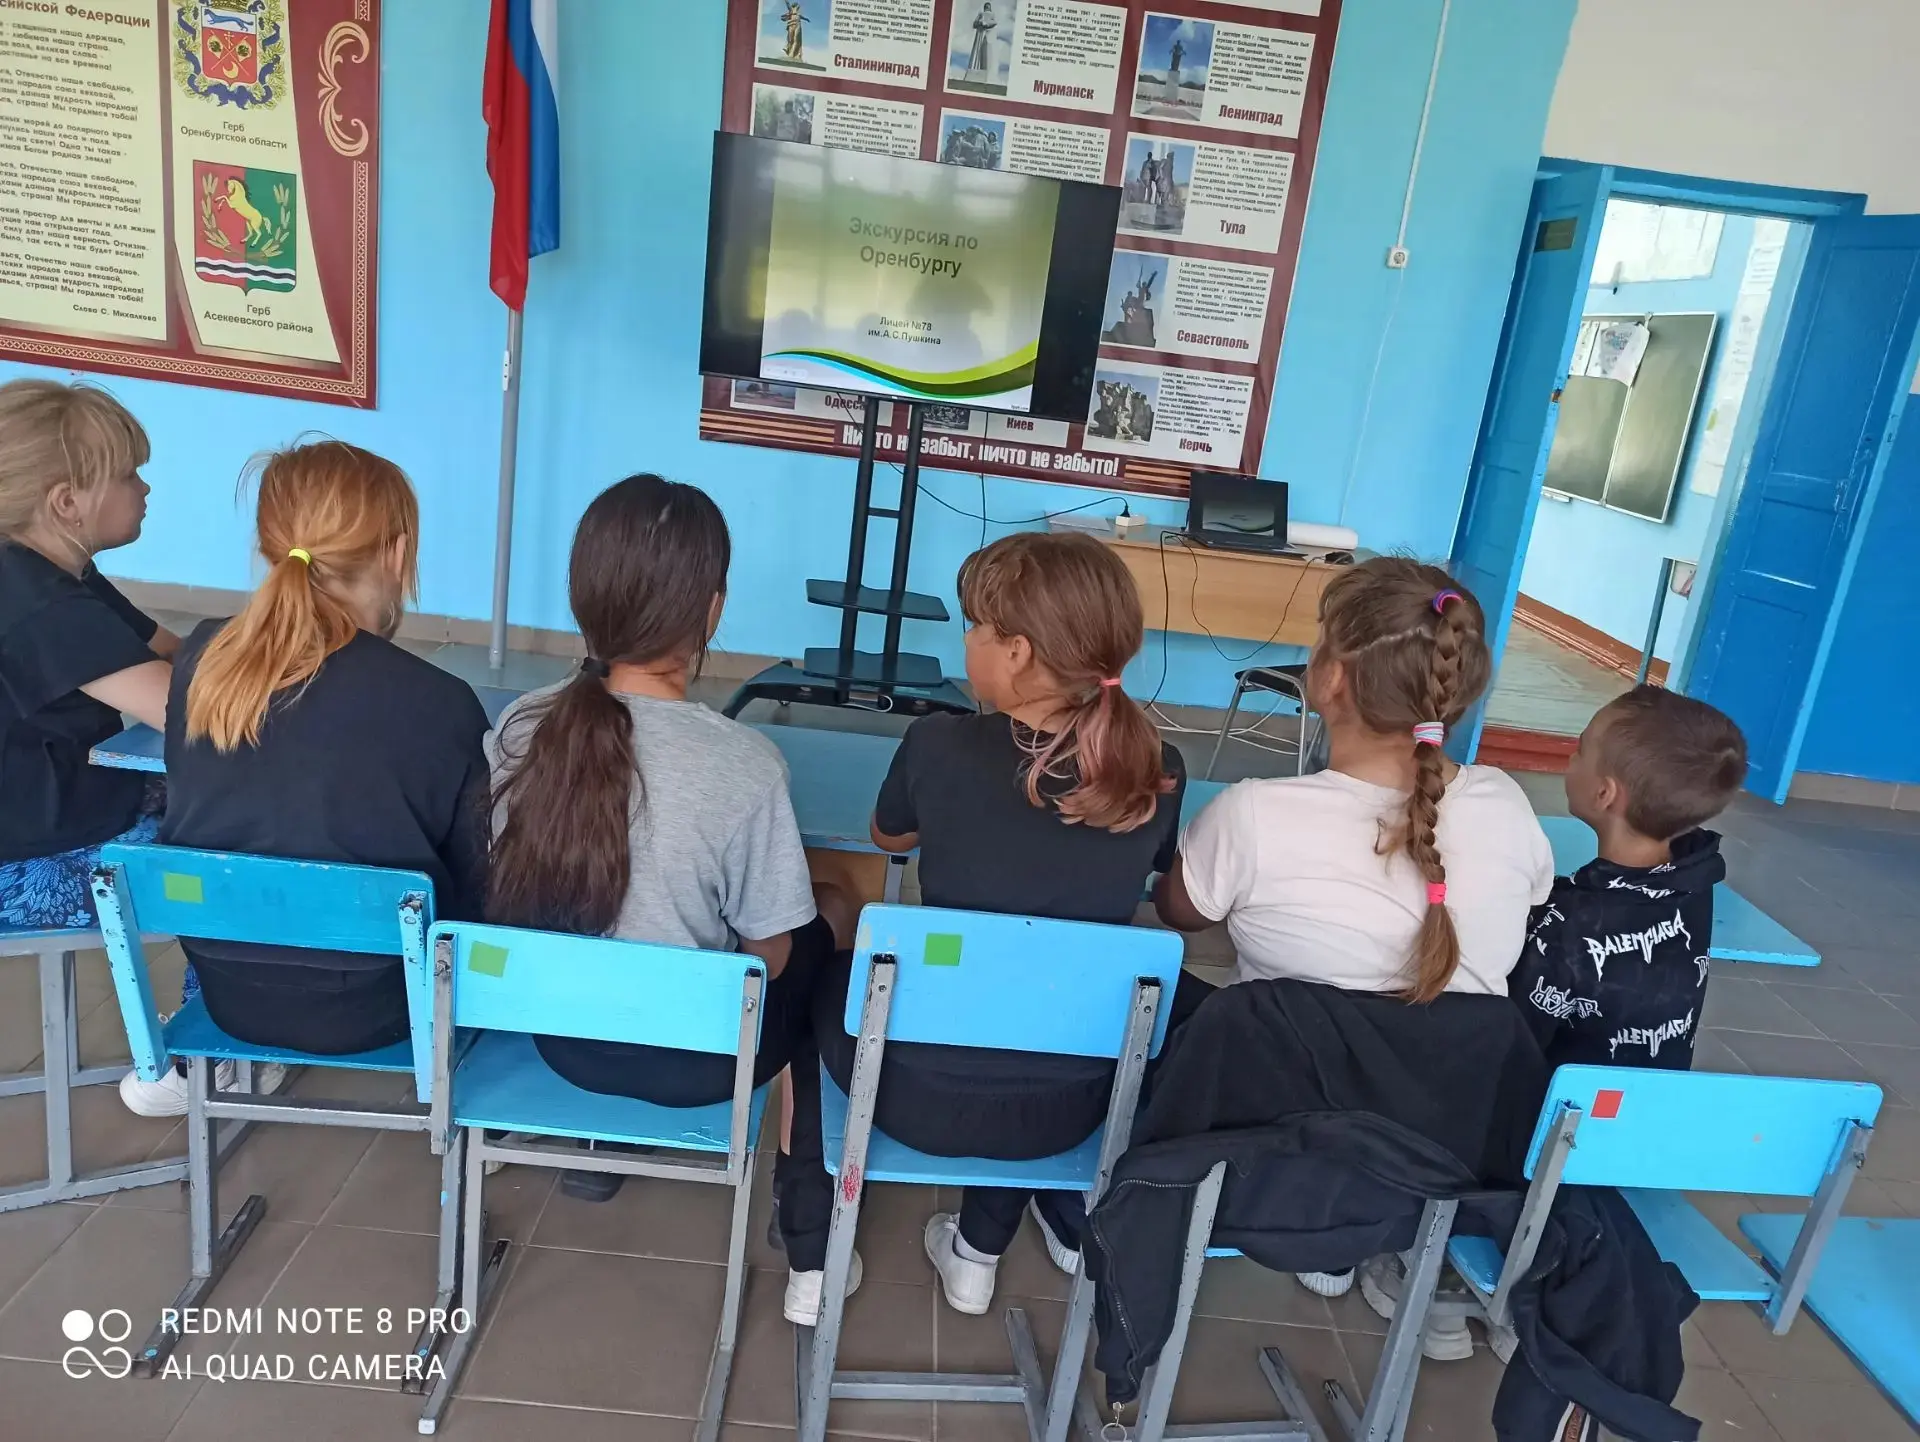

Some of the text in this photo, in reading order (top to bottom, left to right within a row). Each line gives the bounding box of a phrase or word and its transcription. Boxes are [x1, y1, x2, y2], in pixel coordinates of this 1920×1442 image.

[65, 4, 150, 28] Федерации
[834, 53, 920, 79] Сталининград
[1033, 79, 1094, 101] Мурманск
[1218, 104, 1284, 126] Ленинград
[223, 121, 245, 132] Герб
[180, 125, 288, 149] Оренбургской области
[58, 141, 80, 150] Одна
[19, 163, 63, 175] Отечество
[22, 210, 57, 220] простор
[43, 222, 89, 234] открывают
[849, 217, 978, 250] Экскурсия по
[1220, 219, 1246, 235] Тула
[47, 231, 70, 239] наша
[72, 235, 110, 246] верность
[89, 246, 112, 255] будет
[24, 253, 67, 266] Отечество
[860, 245, 962, 278] Оренбургу
[25, 264, 61, 274] народов
[63, 269, 84, 277] союз
[29, 273, 59, 283] данная
[61, 278, 100, 289] мудрость
[76, 289, 115, 300] гордимся
[72, 304, 98, 313] Слова
[112, 310, 157, 322] Михалкова
[246, 304, 271, 316] Герб
[204, 310, 314, 334] Асекеевского района
[1177, 329, 1250, 350] Севастополь
[1006, 417, 1034, 431] Киев
[842, 424, 893, 449] Нито
[920, 436, 974, 461] забыт,
[1030, 449, 1050, 469] не
[1053, 453, 1120, 477] забыто!
[1179, 438, 1212, 453] Керчь
[1583, 908, 1690, 982] BALENCIAGA
